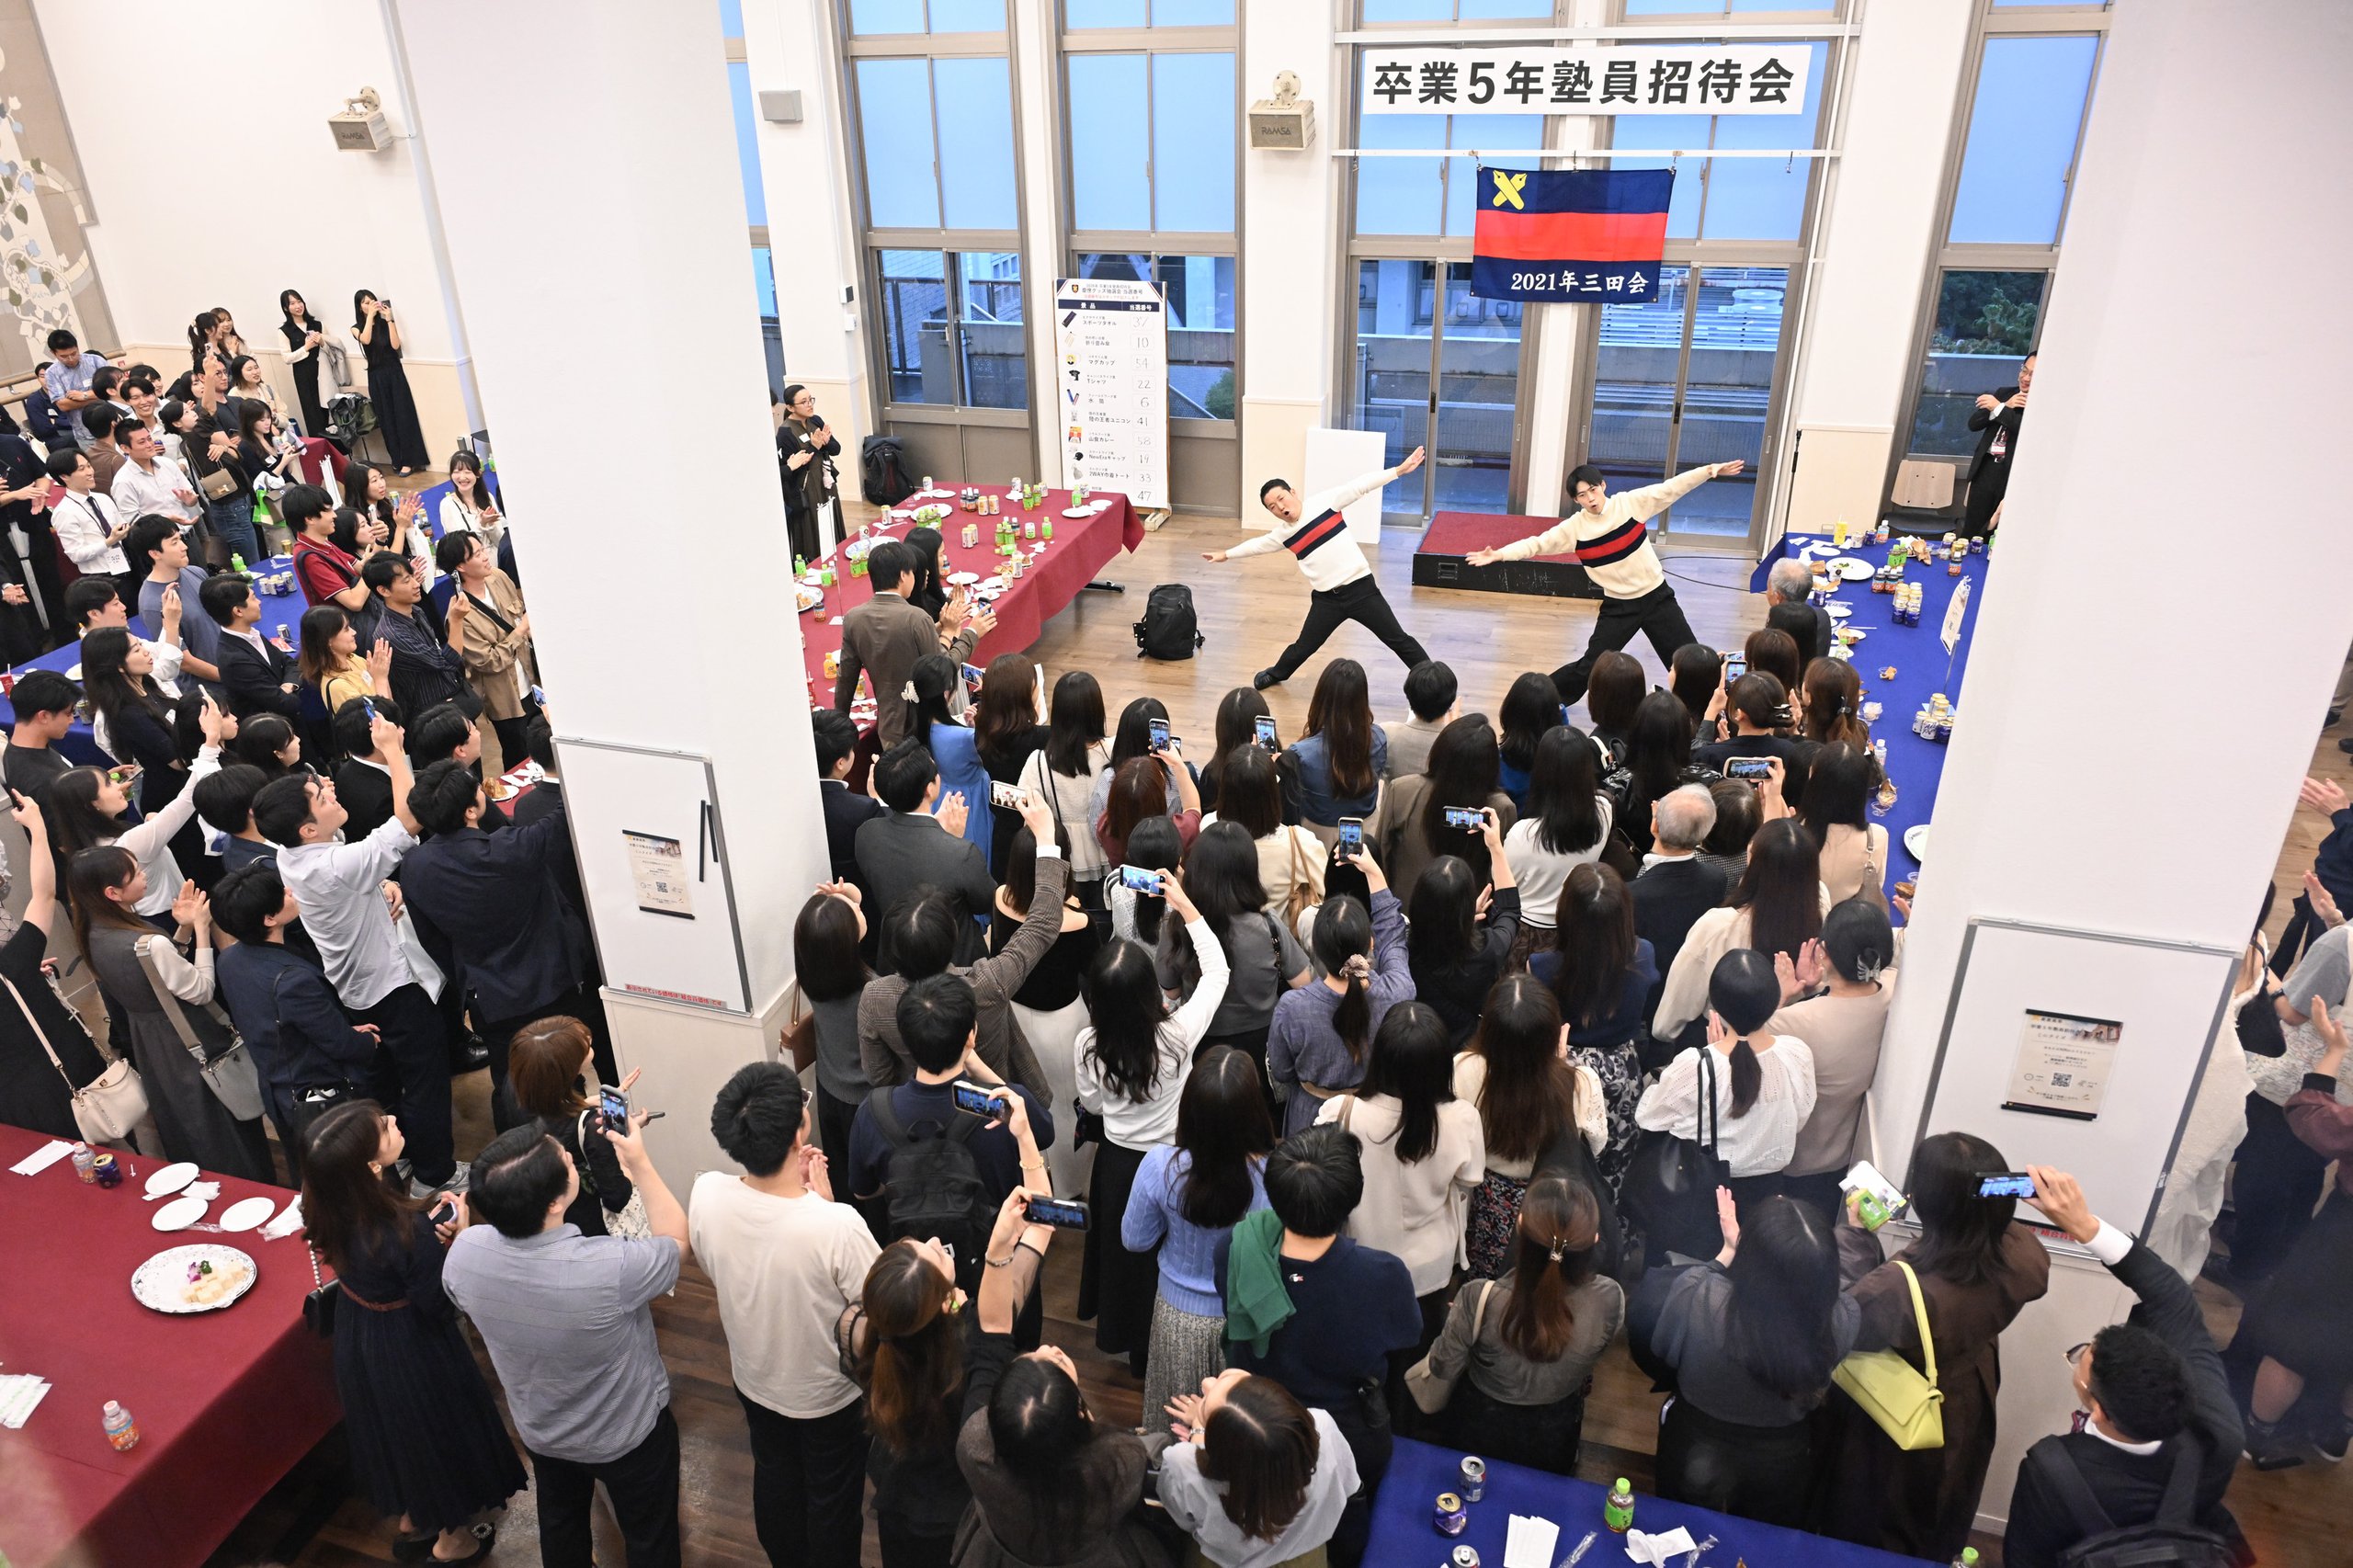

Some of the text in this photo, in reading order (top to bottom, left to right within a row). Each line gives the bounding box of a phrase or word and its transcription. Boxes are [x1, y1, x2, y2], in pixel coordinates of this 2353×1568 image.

[1372, 57, 1796, 106] 卒業5年塾員招待会
[1261, 127, 1291, 135] RAMSA
[1510, 269, 1650, 294] 2021年三田会
[1137, 336, 1150, 348] 10
[1138, 380, 1152, 390] 22
[1140, 397, 1150, 408] 6
[1137, 416, 1148, 426] 41
[1137, 490, 1152, 502] 47
